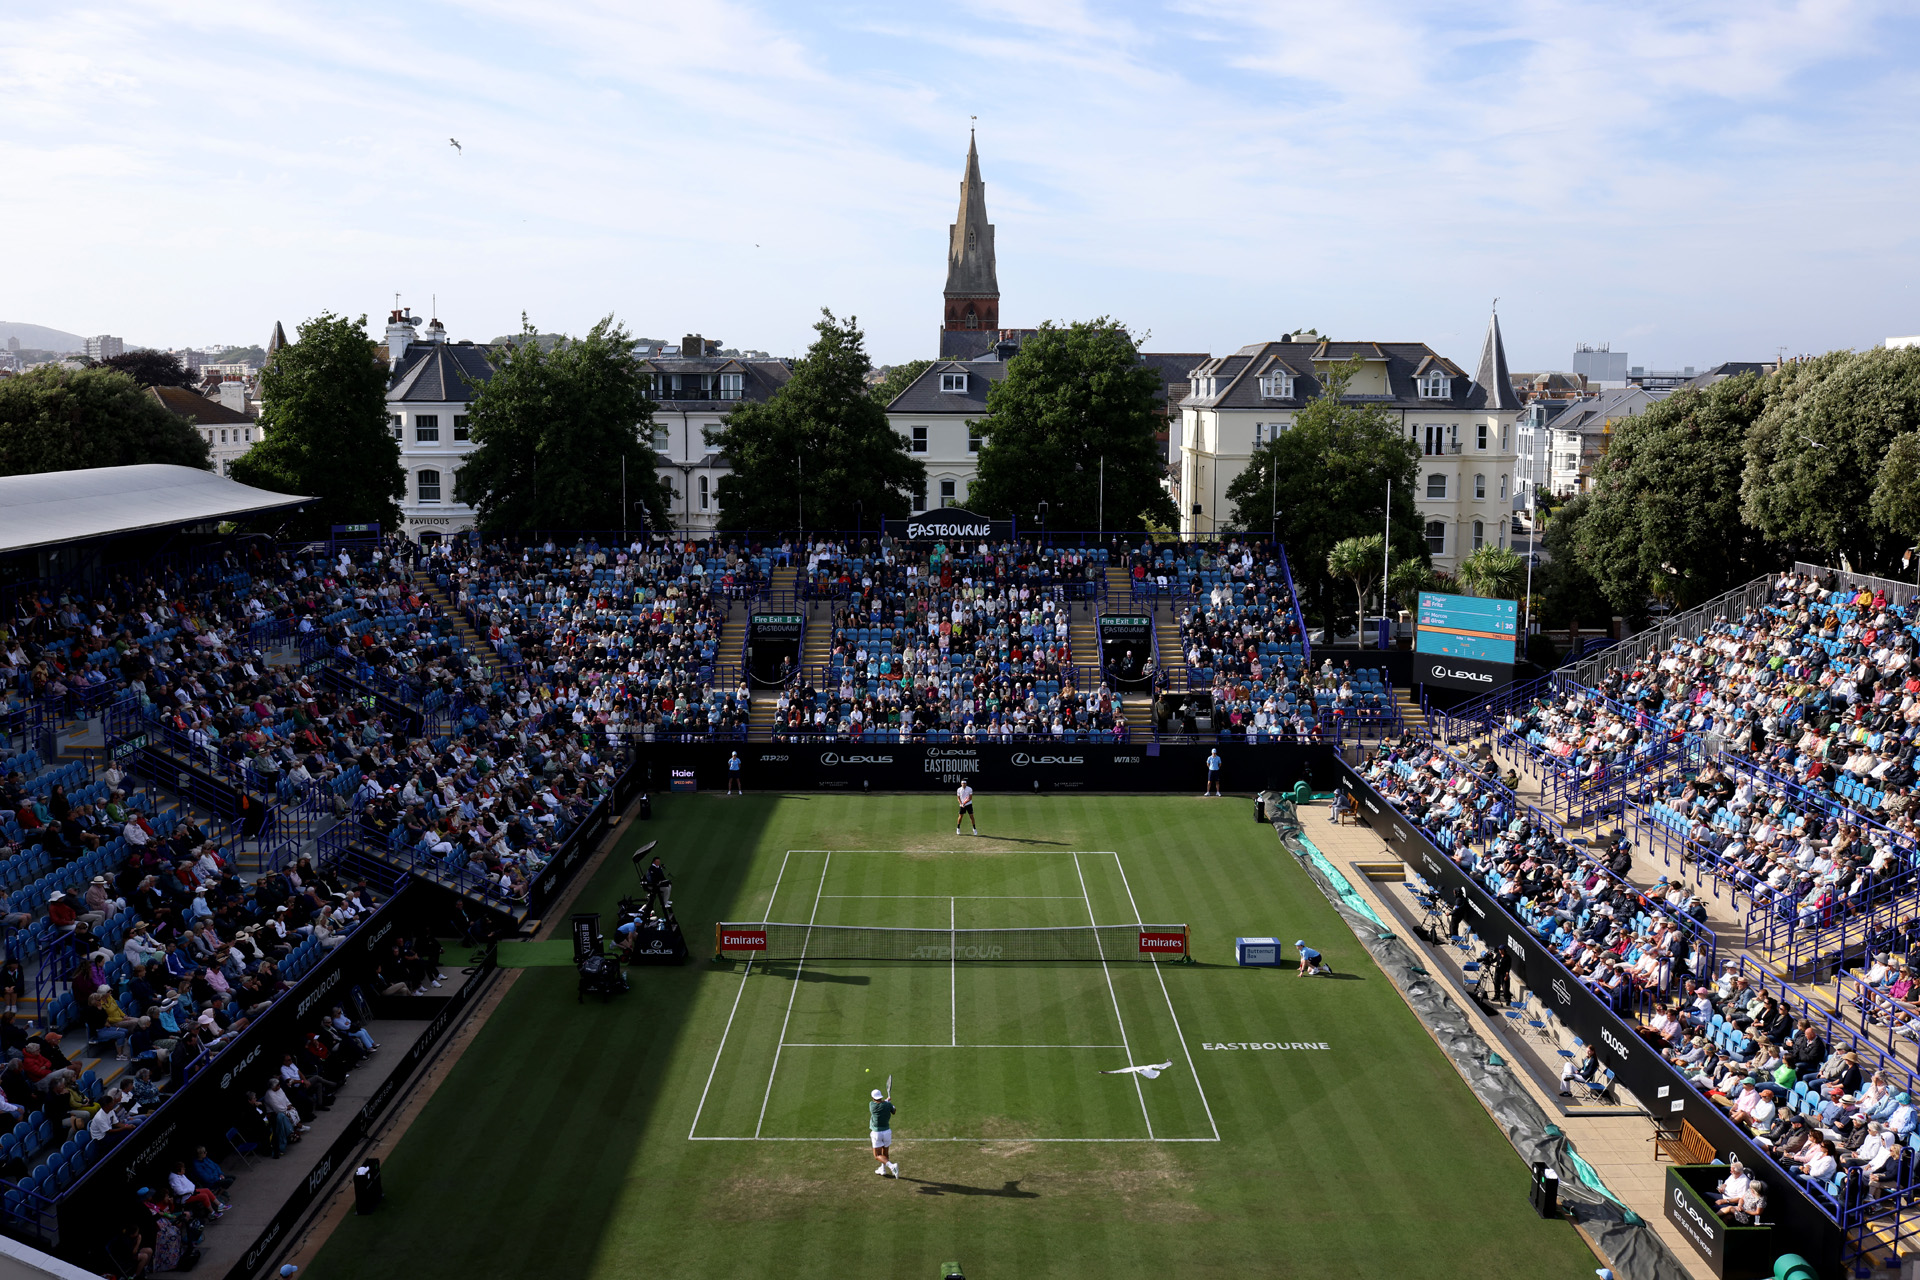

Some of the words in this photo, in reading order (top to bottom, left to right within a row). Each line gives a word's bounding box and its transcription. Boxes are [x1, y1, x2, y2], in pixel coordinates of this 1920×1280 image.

[907, 523, 990, 539] EASTBOURNE
[1101, 617, 1115, 625] Fire
[1115, 617, 1129, 625] Exit
[757, 624, 799, 633] EASTBOURNE
[1103, 625, 1146, 634] EASTBOURNE
[1447, 669, 1493, 683] LEXUS
[840, 755, 894, 764] LEXUS
[924, 759, 980, 773] EASTBOURNE
[1031, 756, 1084, 764] LEXUS
[1113, 756, 1130, 764] WTA
[1130, 756, 1140, 764] 250
[672, 769, 695, 777] Haier
[943, 774, 961, 783] OPEN
[375, 920, 392, 944] LEXUS
[582, 931, 591, 955] BRITA
[723, 935, 765, 945] Emirates
[1141, 937, 1182, 947] Emirates
[910, 945, 951, 960] ATP
[954, 945, 1004, 960] TOUR
[1201, 1042, 1331, 1050] EASTBOURNE
[1601, 1026, 1628, 1060] HOLOGIC
[233, 1044, 262, 1079] FAGE
[136, 1145, 151, 1164] CREW
[151, 1121, 177, 1150] CLOTHING
[145, 1137, 169, 1165] COMPANY
[309, 1154, 332, 1195] Haier
[1684, 1200, 1714, 1240] LEXUS
[257, 1222, 280, 1257] LEXUS
[1699, 1239, 1713, 1258] HOUSE
